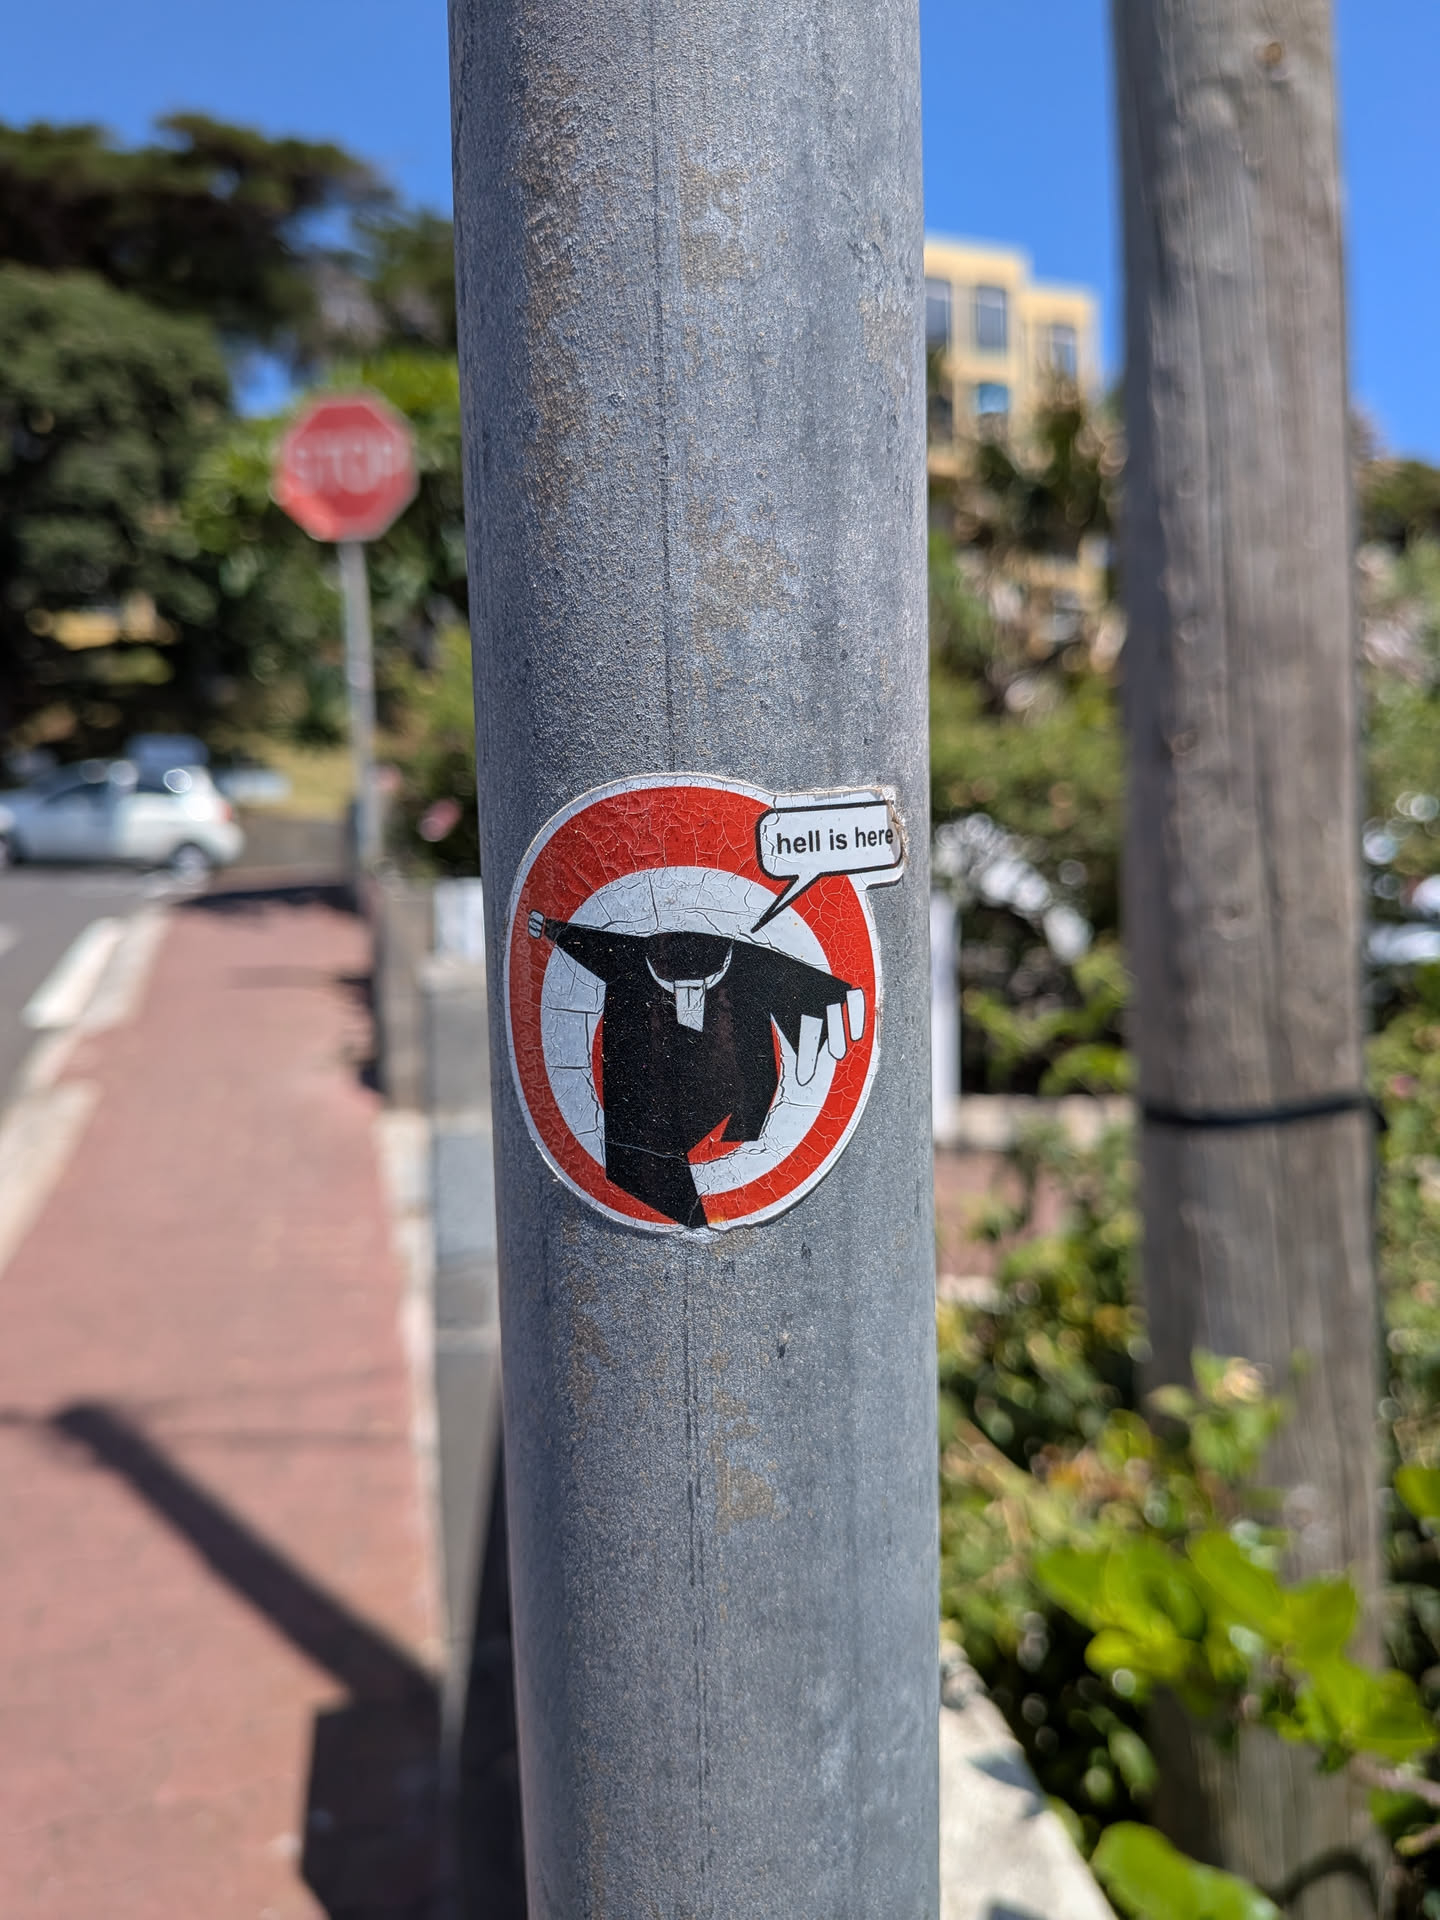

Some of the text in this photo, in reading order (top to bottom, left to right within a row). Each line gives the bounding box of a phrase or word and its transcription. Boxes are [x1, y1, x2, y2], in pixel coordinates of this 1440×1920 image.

[290, 437, 408, 488] STOP
[776, 826, 894, 854] hell is here
